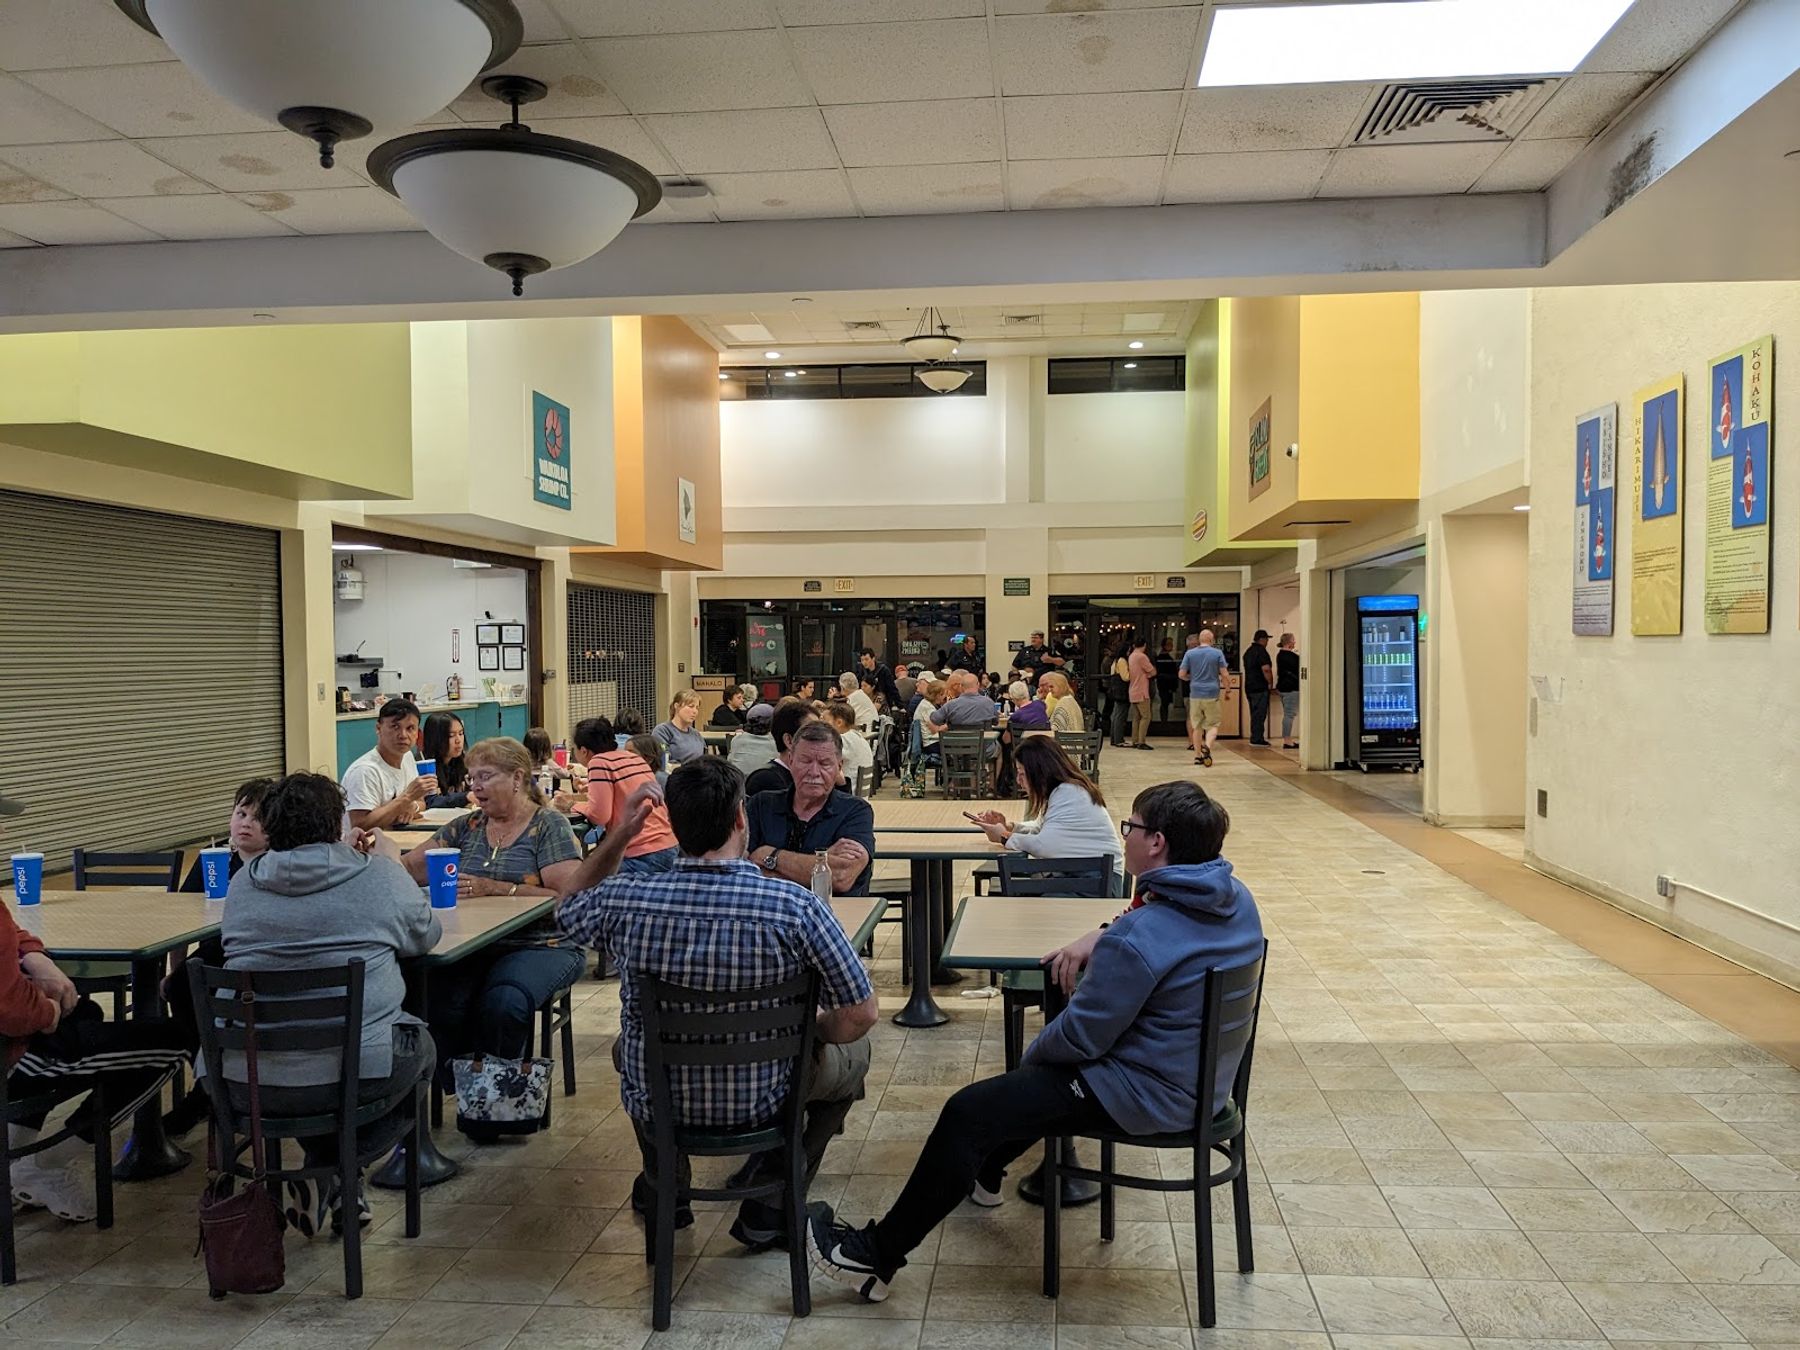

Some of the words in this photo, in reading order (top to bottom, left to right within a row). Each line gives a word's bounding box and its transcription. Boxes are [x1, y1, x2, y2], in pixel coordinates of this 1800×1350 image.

[1751, 347, 1761, 421] KOHAKU
[838, 580, 851, 590] EXIT
[1137, 576, 1151, 587] EXIT
[16, 866, 29, 895] pepsi
[205, 860, 219, 888] pepsi
